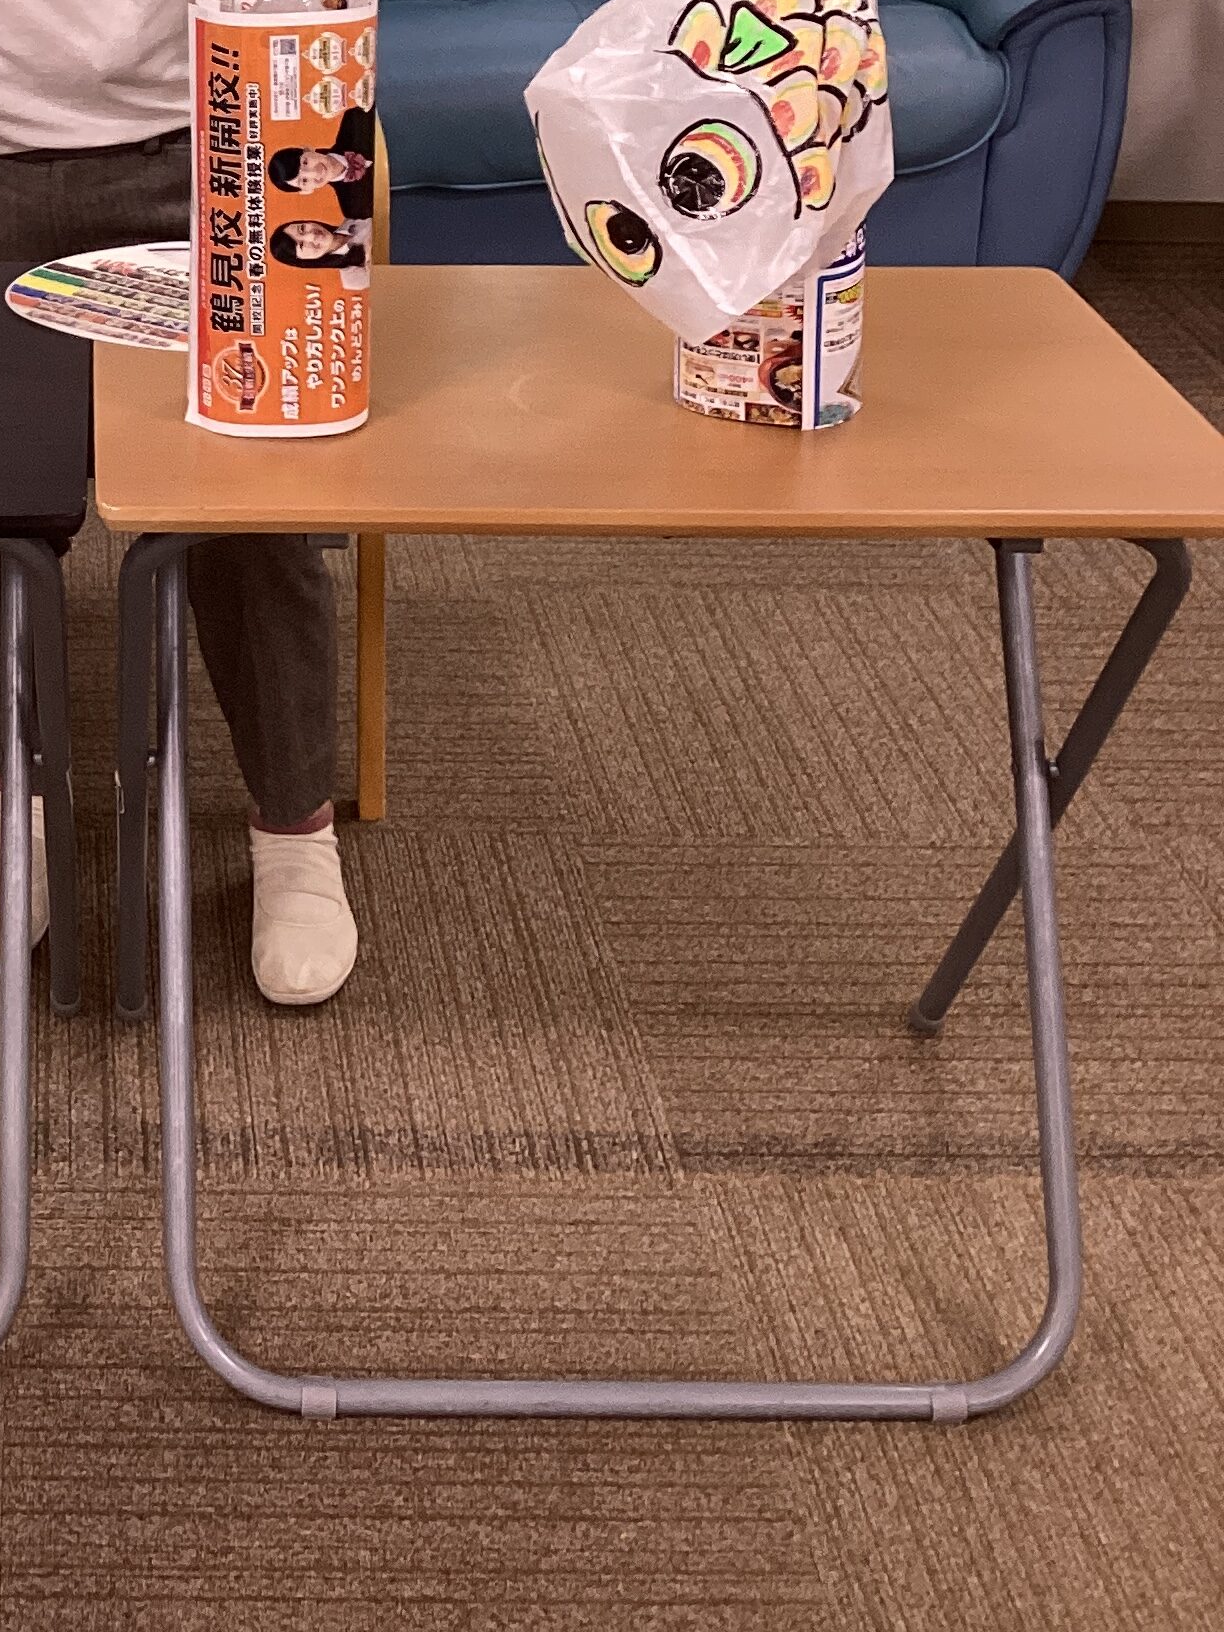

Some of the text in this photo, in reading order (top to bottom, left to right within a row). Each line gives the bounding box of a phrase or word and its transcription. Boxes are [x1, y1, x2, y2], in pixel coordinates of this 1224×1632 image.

[208, 41, 242, 199] 新開校!!
[246, 145, 263, 277] 春の無料体験授業
[209, 207, 244, 334] 鶴見校
[304, 284, 323, 390] やり方しだい!
[330, 299, 346, 409] ワンランク上の
[351, 296, 363, 382] めんどうみ!
